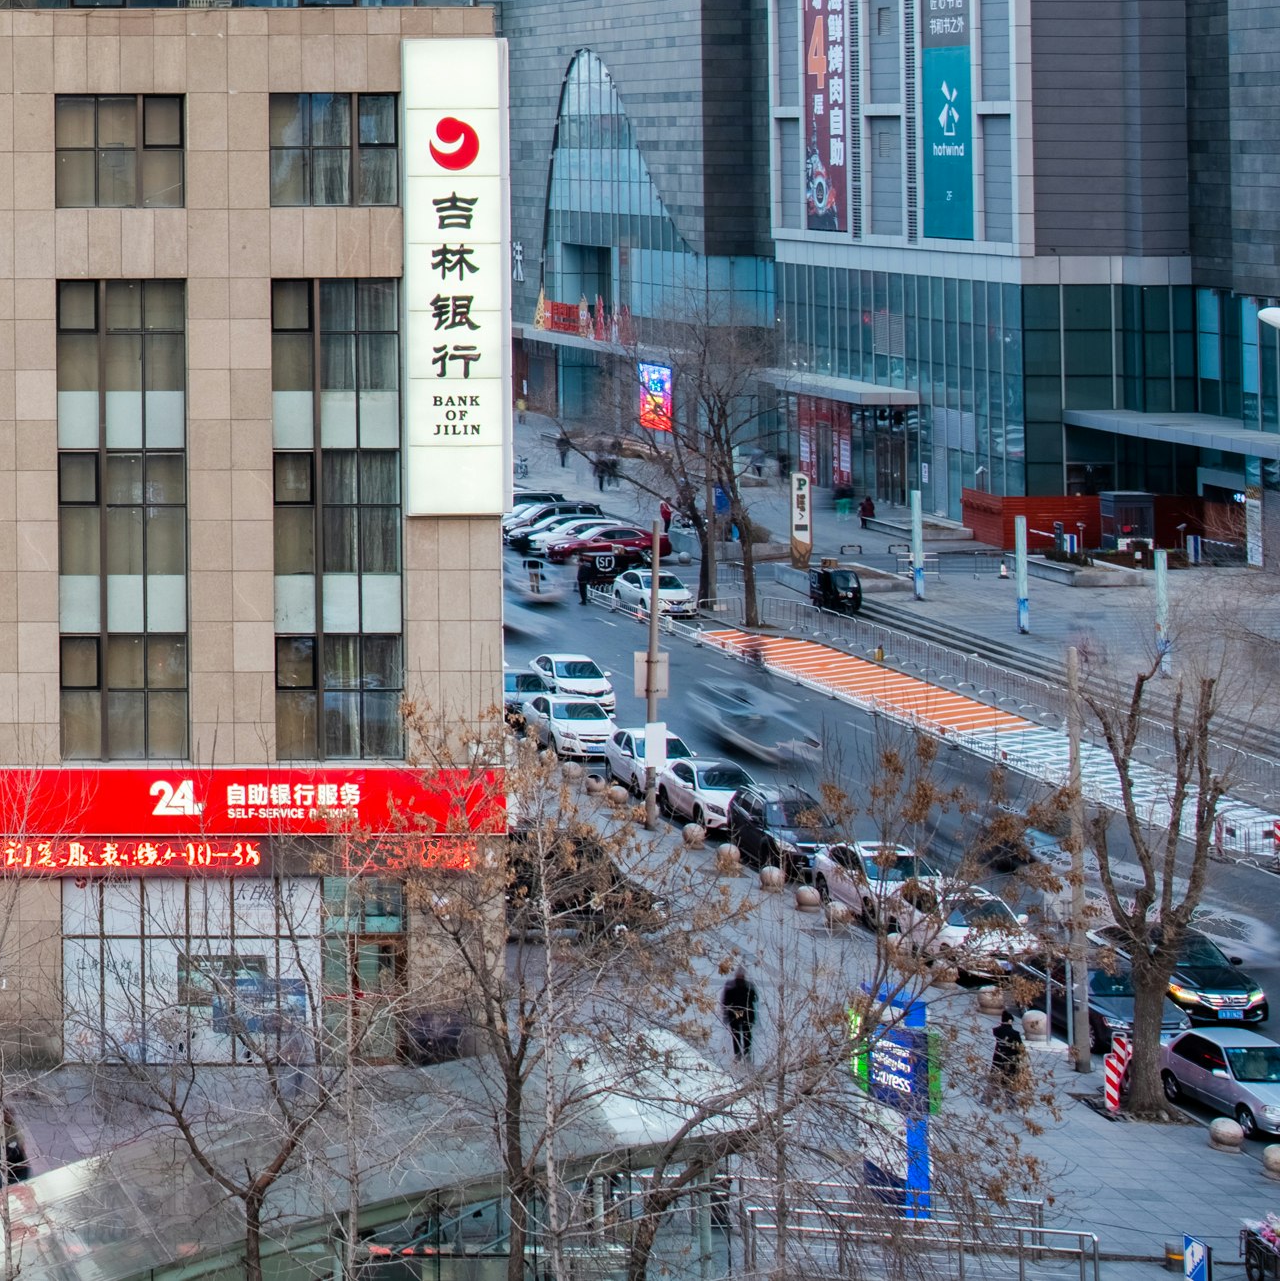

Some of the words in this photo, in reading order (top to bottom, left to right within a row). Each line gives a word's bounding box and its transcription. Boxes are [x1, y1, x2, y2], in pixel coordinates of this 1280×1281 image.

[929, 17, 965, 35] 书和书之外
[807, 14, 827, 89] 4
[932, 142, 965, 156] hotwind
[429, 191, 481, 379] 吉林银行
[433, 395, 481, 407] BANK
[445, 410, 468, 421] OF
[433, 423, 481, 436] JILIN
[227, 783, 360, 806] 自助银行服务
[228, 808, 304, 818] SELF-SERVICE
